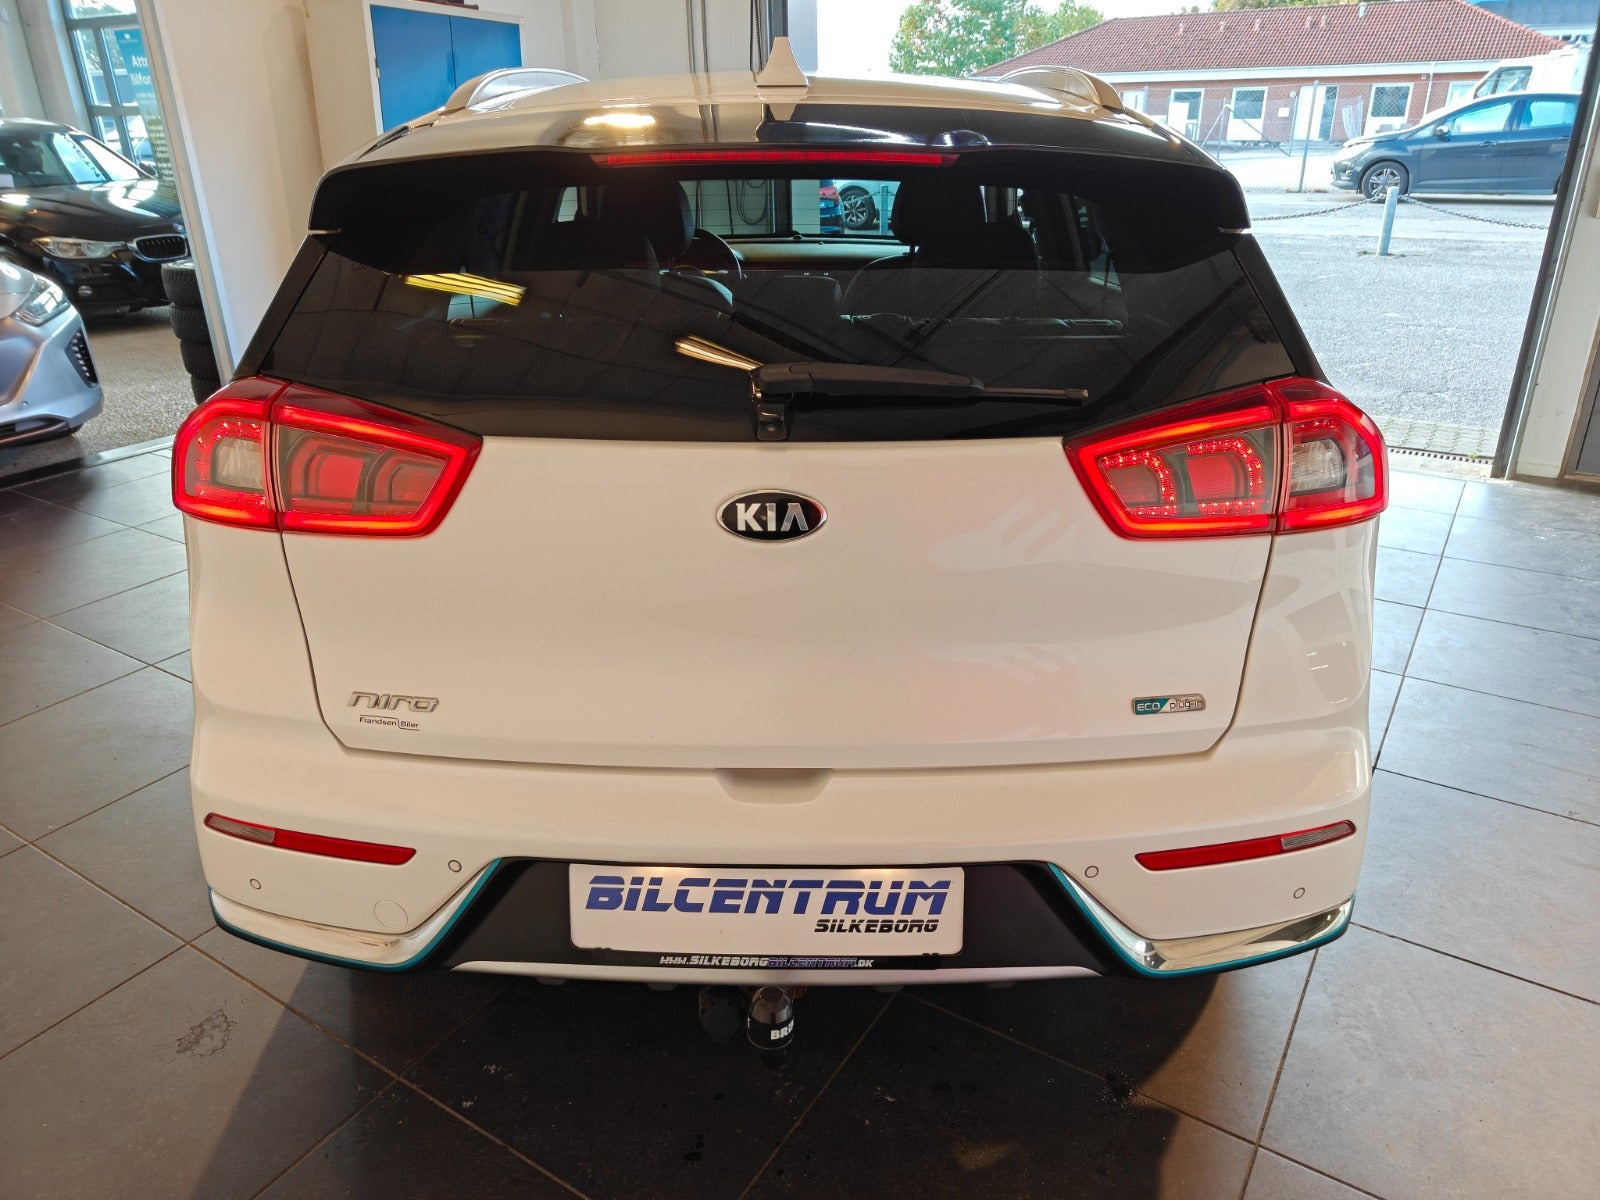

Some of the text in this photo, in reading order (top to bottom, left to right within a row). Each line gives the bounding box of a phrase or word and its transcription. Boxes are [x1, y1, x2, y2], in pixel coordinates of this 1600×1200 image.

[735, 502, 809, 532] KIA
[1137, 702, 1161, 711] ECO
[359, 717, 420, 729] Frandsen Biler
[585, 875, 952, 916] BILCENTRUM
[814, 918, 940, 934] SILKEBORG
